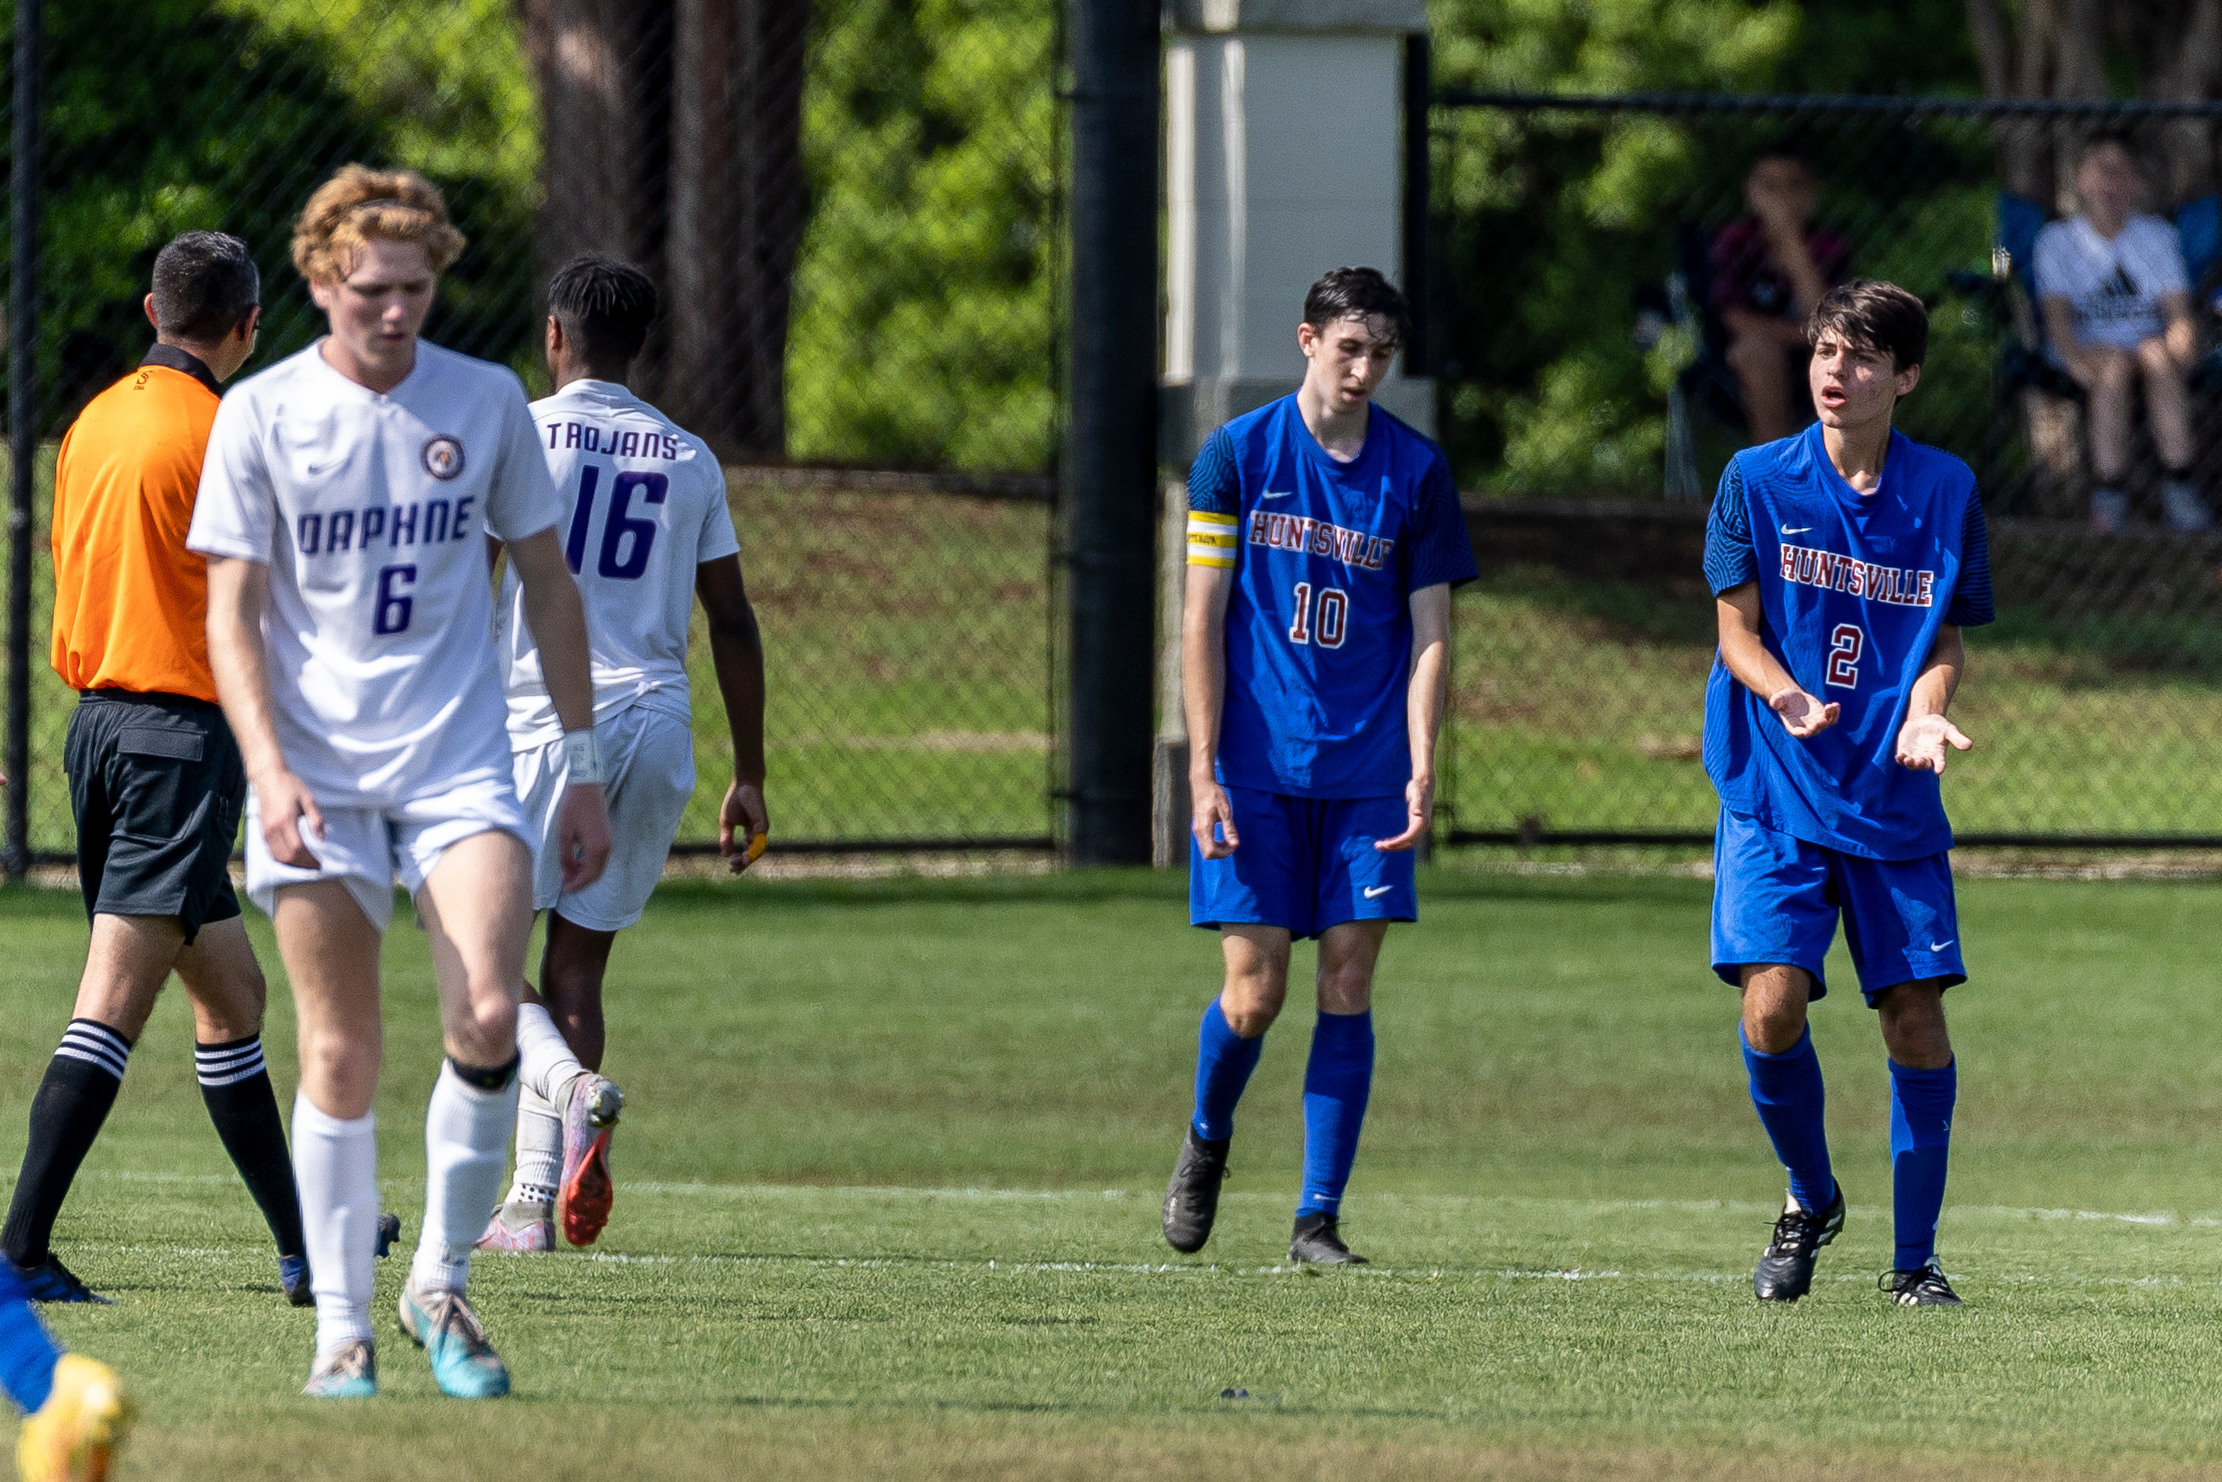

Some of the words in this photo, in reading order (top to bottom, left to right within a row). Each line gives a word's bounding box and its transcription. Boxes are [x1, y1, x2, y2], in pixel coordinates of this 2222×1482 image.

[547, 422, 677, 461] TROJANS
[298, 496, 475, 555] DAPHNE
[565, 465, 669, 580] 16
[1250, 510, 1395, 570] HUNTSVILLE
[373, 564, 417, 634] 6
[1779, 543, 1934, 607] HUNTSVILLE
[1289, 582, 1348, 649] 10
[1825, 623, 1864, 689] 2
